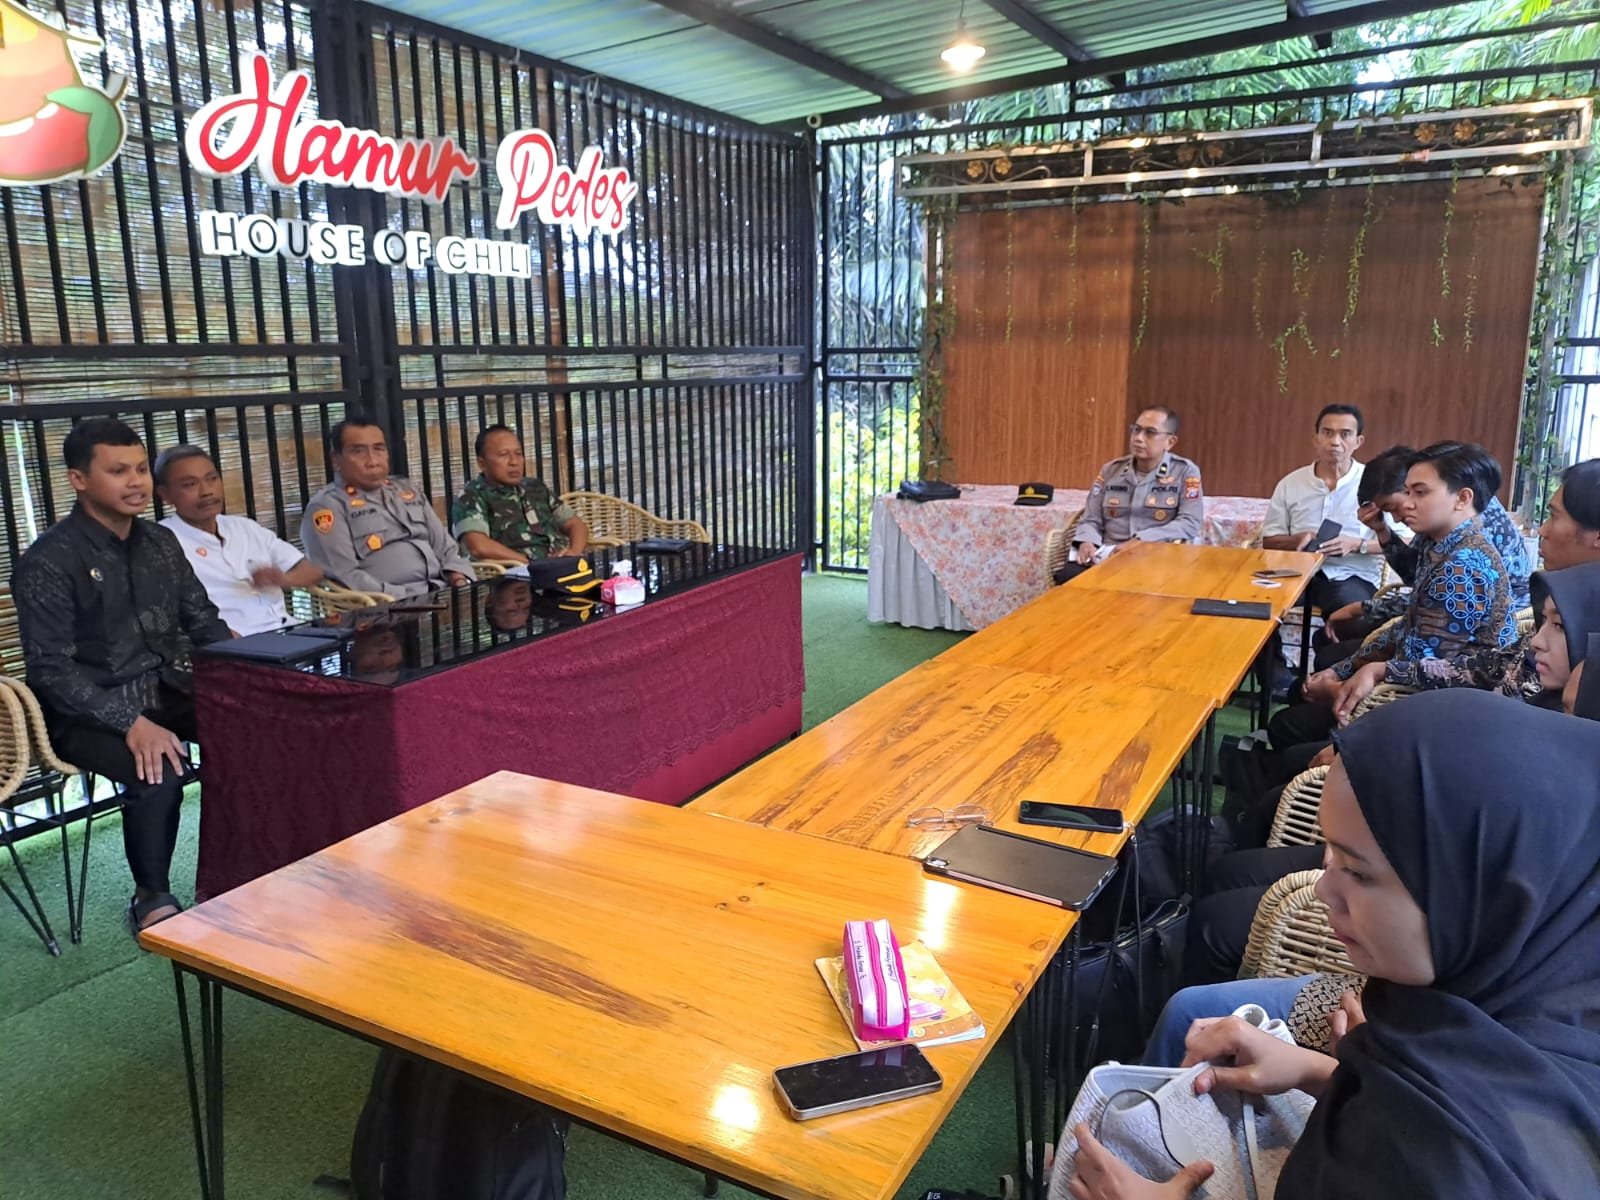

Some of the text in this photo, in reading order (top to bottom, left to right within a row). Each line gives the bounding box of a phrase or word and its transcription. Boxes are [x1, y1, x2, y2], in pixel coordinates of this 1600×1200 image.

[197, 53, 637, 230] Hamur Pedes
[211, 214, 531, 276] HOUSE OF CHILI
